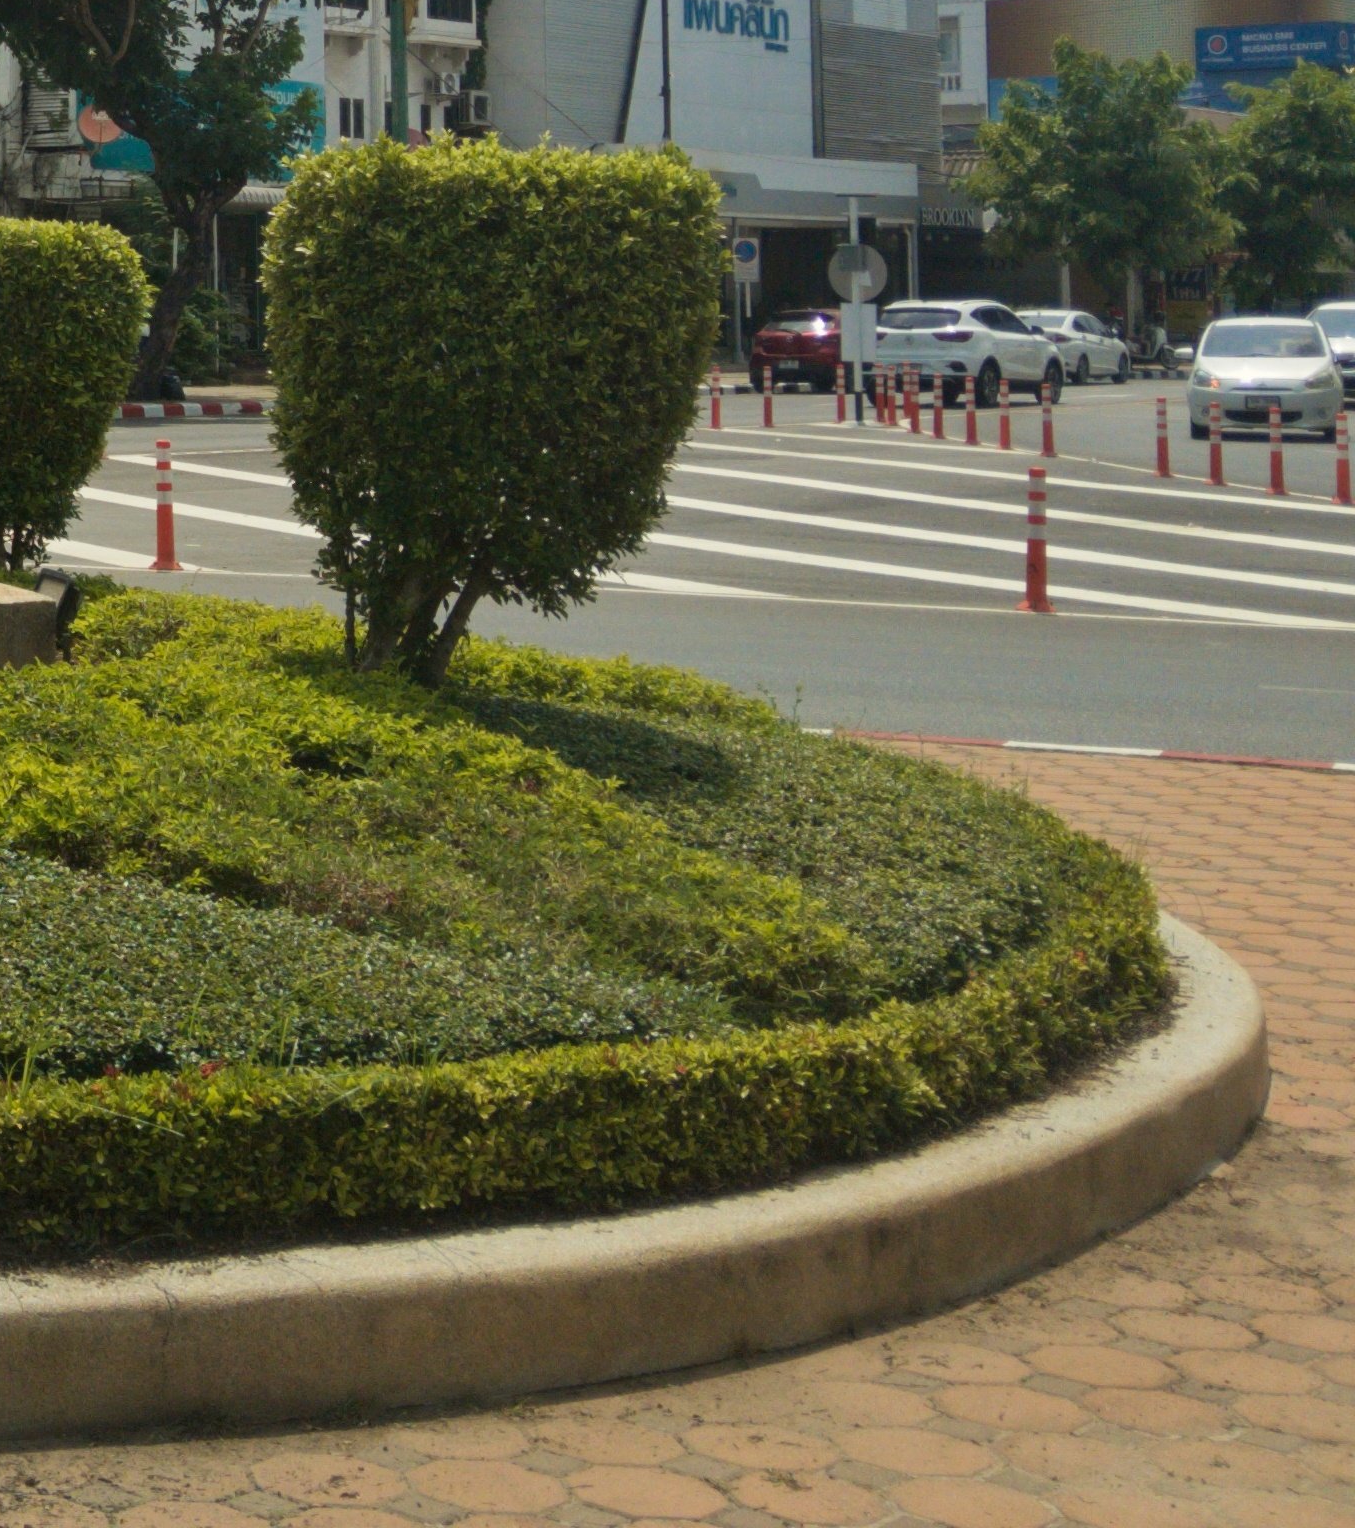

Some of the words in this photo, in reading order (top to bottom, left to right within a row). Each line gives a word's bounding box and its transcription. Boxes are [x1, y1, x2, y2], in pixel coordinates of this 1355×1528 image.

[1242, 32, 1273, 42] MICRO
[1242, 43, 1288, 54] BUSINESS
[1289, 41, 1327, 52] CENTER
[920, 206, 974, 226] BROOKLYN
